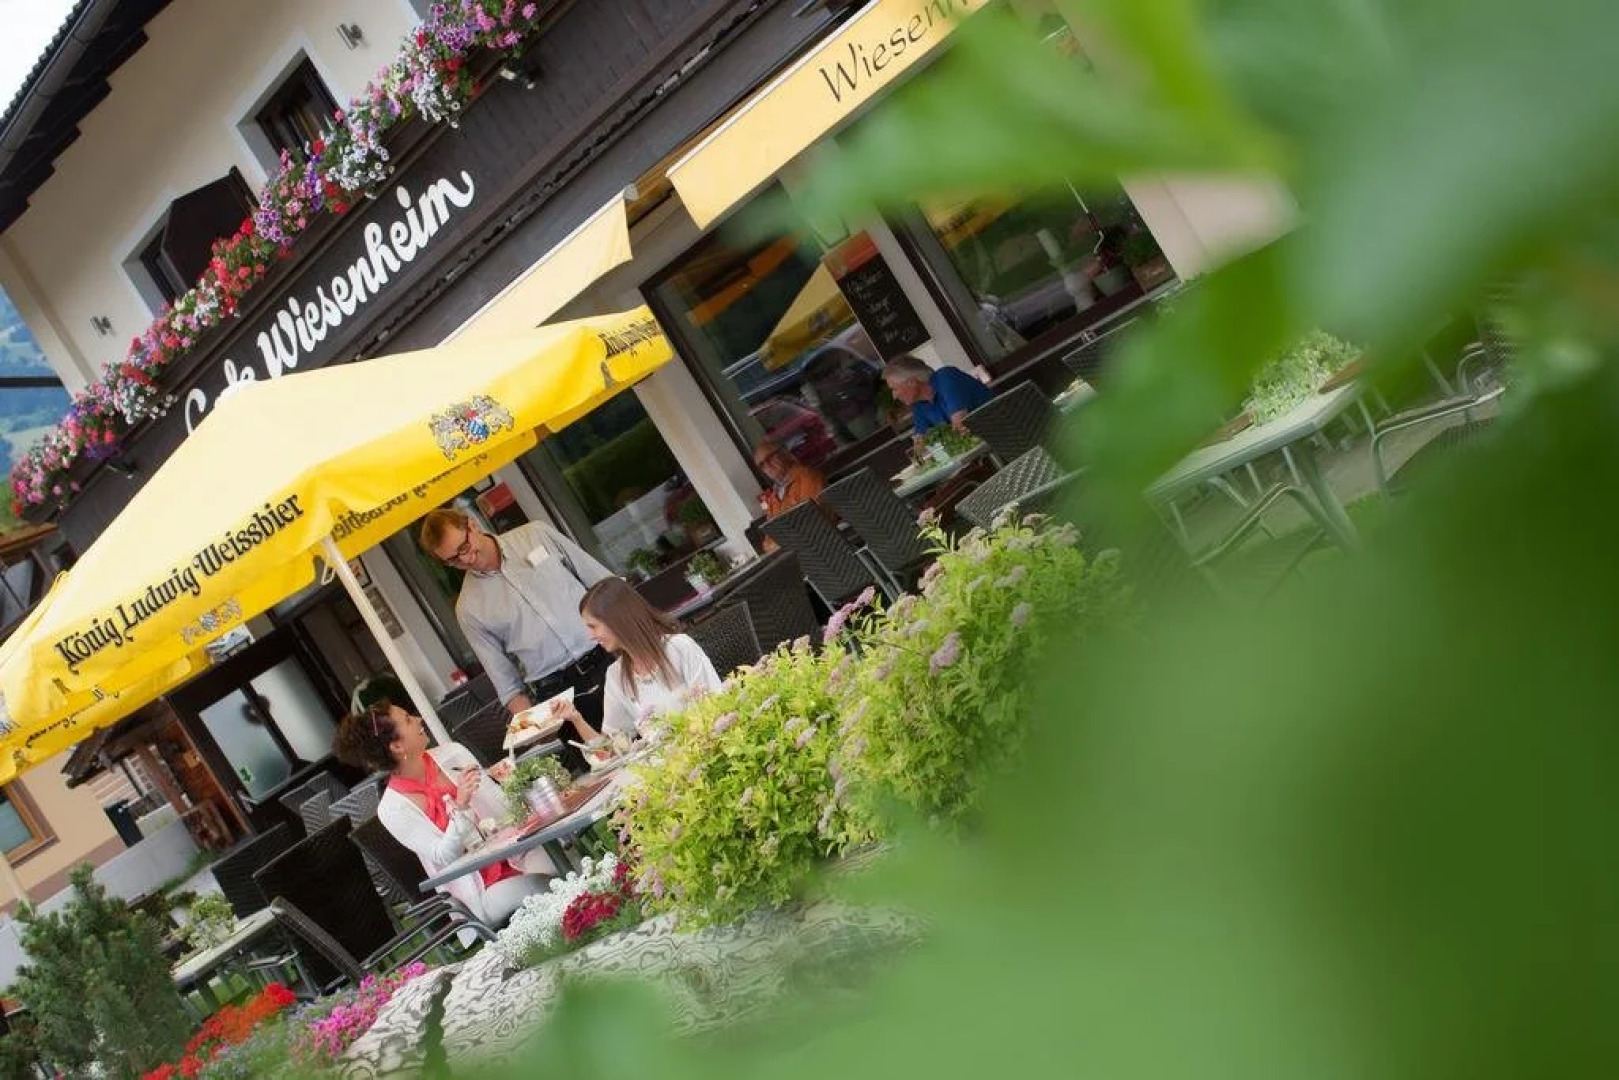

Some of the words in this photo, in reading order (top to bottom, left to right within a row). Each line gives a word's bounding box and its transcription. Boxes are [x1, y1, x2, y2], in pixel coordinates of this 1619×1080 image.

[256, 170, 475, 381] Wiesenheim
[55, 616, 125, 675] König
[114, 566, 201, 642] Ludwig
[193, 494, 304, 579] Weissbier
